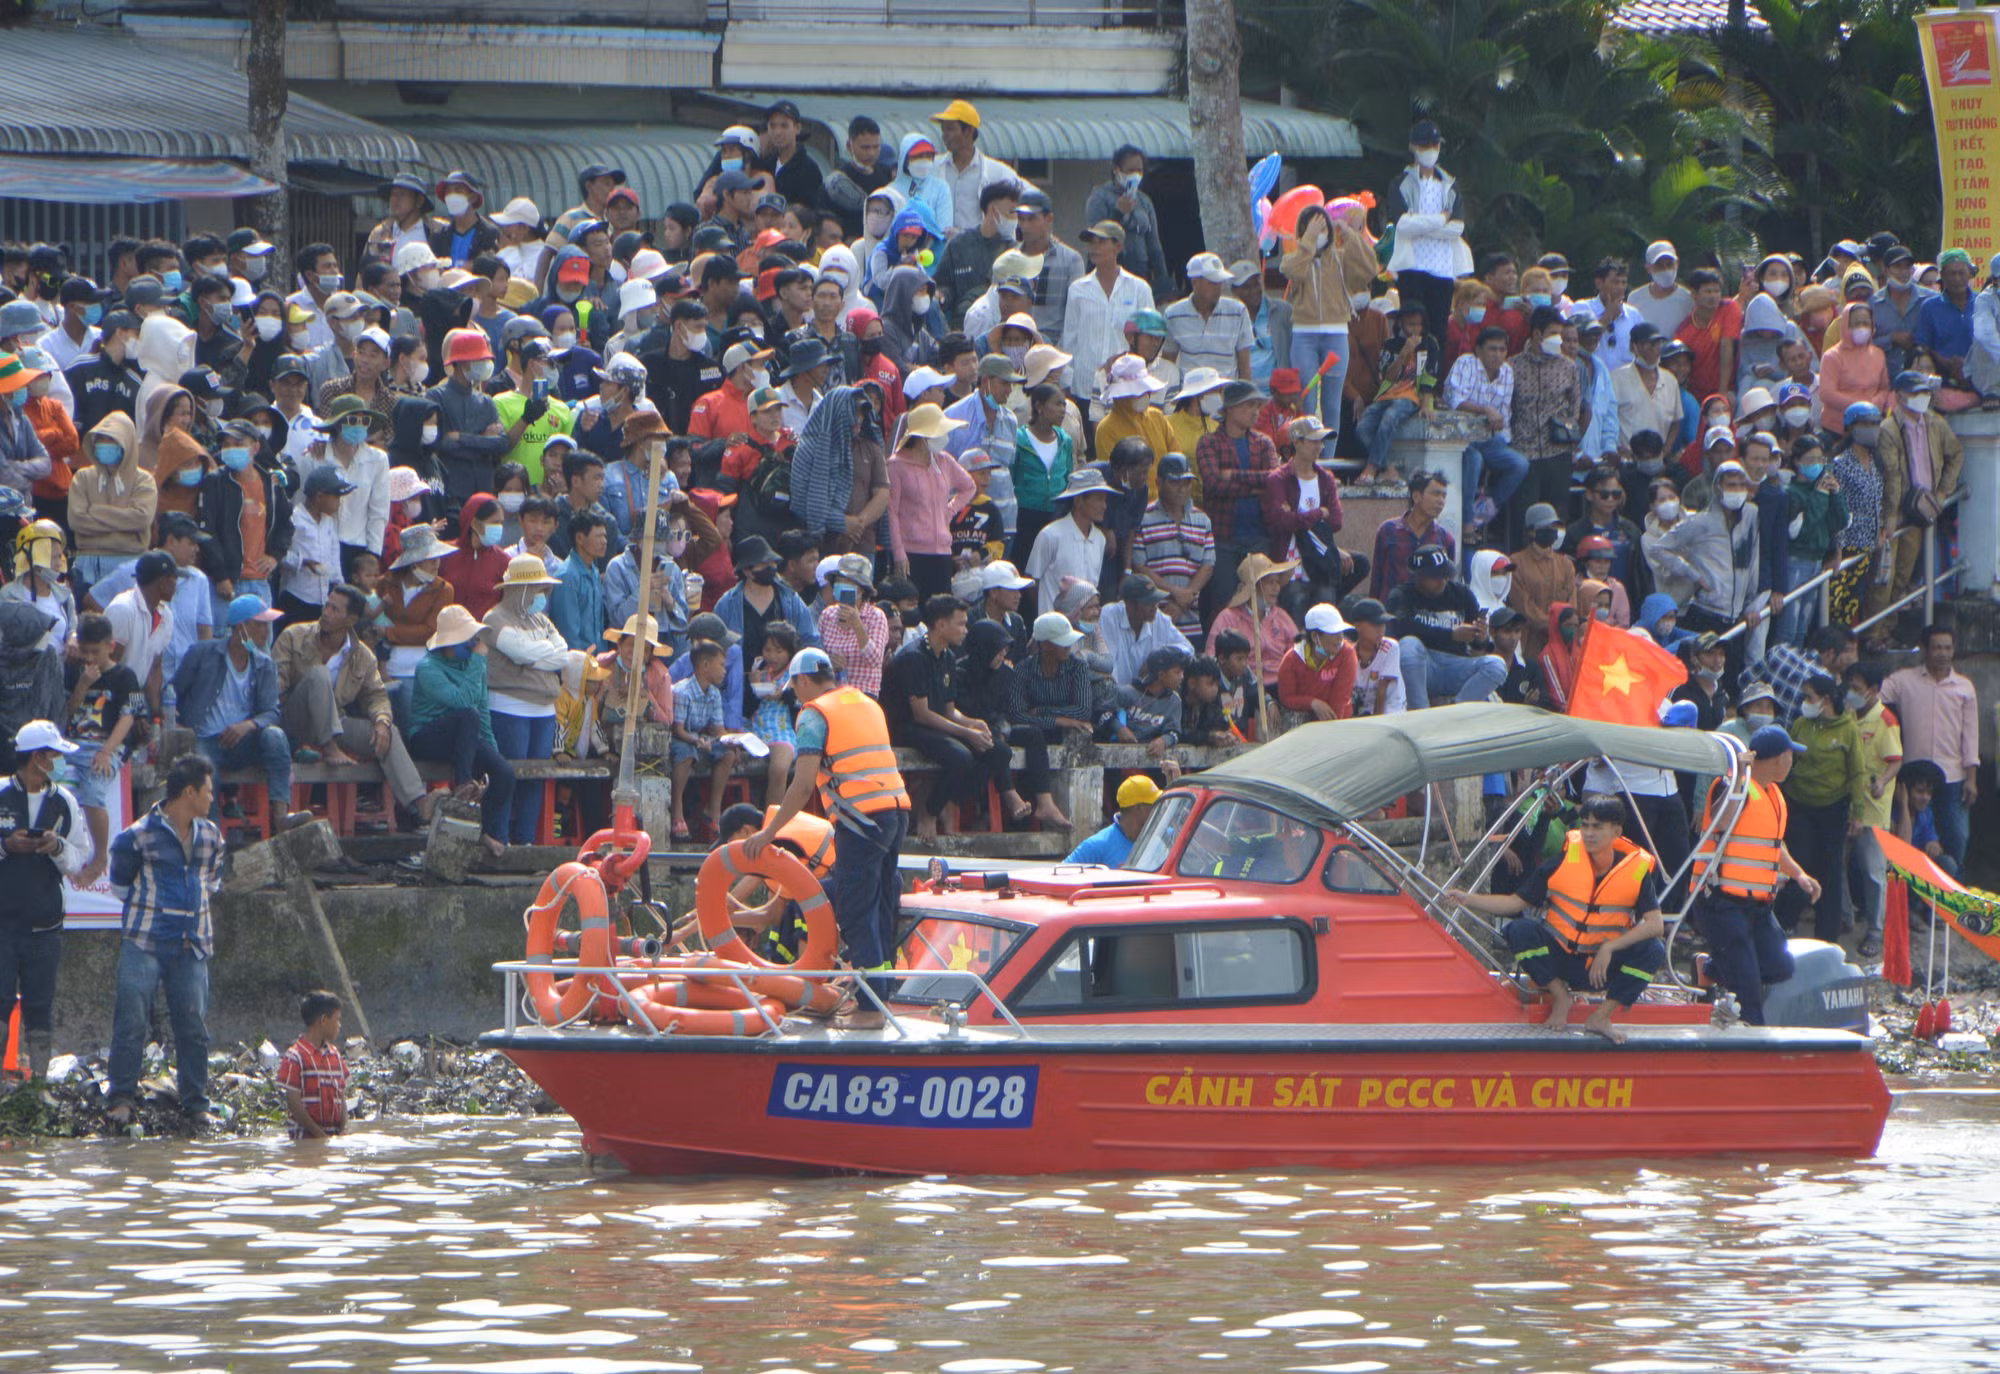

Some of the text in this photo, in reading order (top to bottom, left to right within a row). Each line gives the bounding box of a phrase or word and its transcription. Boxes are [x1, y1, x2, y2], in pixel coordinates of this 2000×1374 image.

[1822, 987, 1864, 1010] YAMAHA
[1145, 1067, 1633, 1108] CẢNH SÁT PCCC VÀ CNCH
